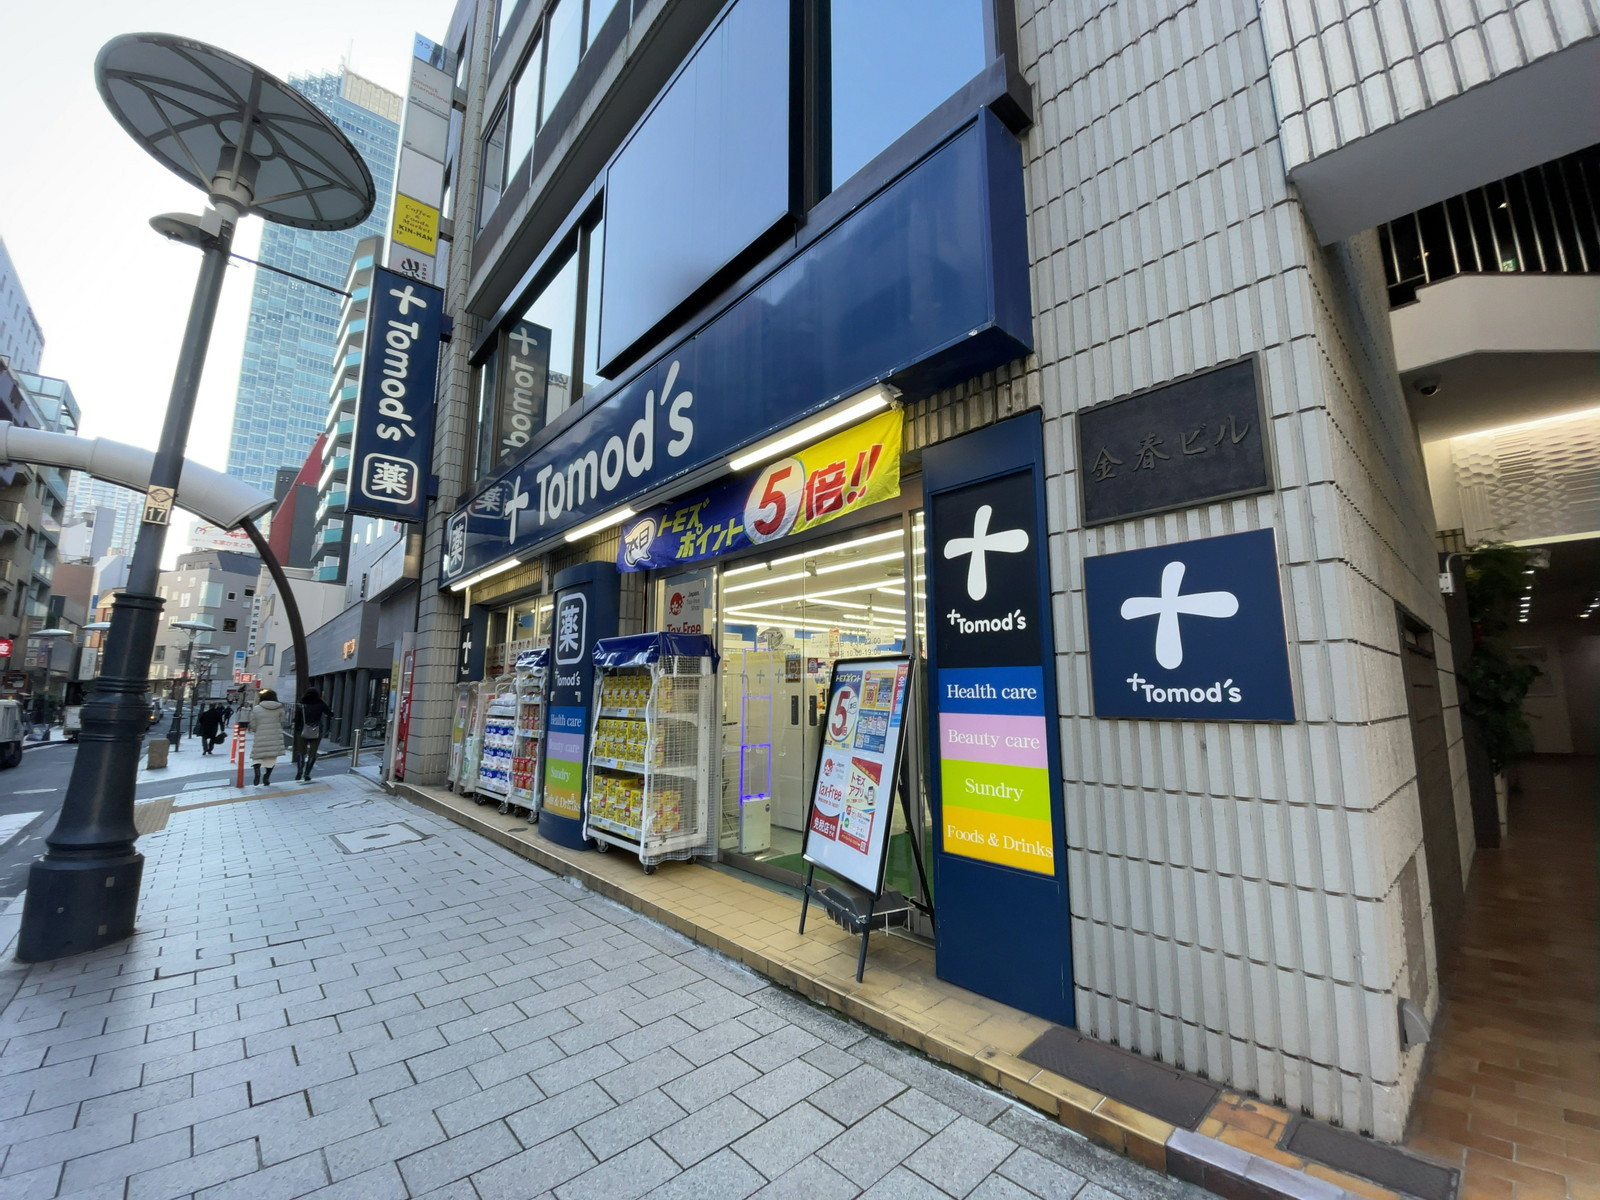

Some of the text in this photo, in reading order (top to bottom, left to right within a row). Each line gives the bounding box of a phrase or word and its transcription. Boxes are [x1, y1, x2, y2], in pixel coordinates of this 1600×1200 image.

[405, 204, 431, 219] Coffee
[405, 214, 429, 228] Foods
[403, 218, 430, 233] Market
[376, 320, 419, 442] Tomod's
[537, 360, 694, 526] Tomod's
[1091, 415, 1250, 483] 金春ビル
[371, 461, 409, 498] 薬
[148, 508, 166, 522] 17
[657, 497, 710, 537] トモズ
[450, 523, 465, 567] 薬
[675, 518, 744, 559] ポイント
[559, 605, 579, 652] 薬
[957, 608, 1027, 635] Tomod's
[557, 671, 581, 687] Tomod's
[1140, 678, 1243, 703] Tomod's
[947, 683, 1037, 701] Health care
[551, 713, 582, 728] Health care
[565, 743, 580, 753] care
[948, 728, 1040, 750] Beauty care
[551, 766, 571, 783] Sundry
[965, 778, 1024, 802] Sundry
[947, 824, 1053, 859] Foods & Drinks
